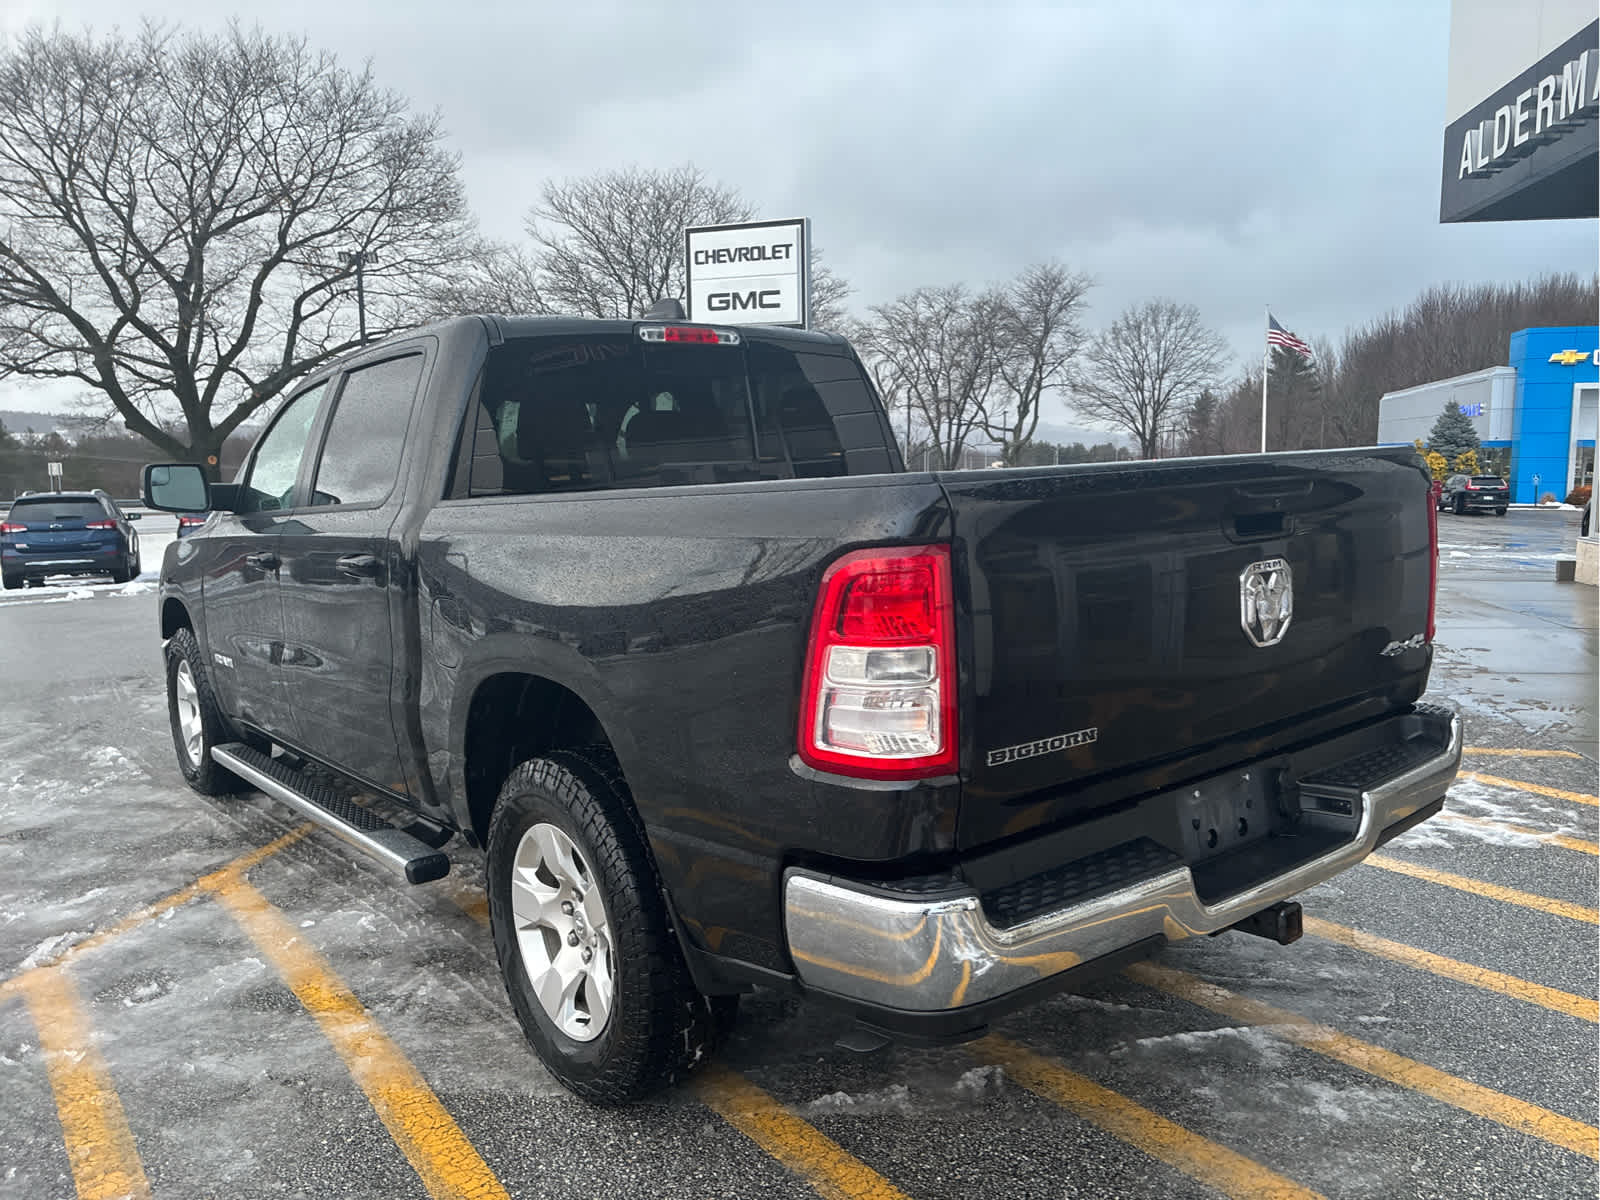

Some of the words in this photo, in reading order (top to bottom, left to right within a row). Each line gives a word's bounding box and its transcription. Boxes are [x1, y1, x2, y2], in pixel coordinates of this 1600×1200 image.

[694, 244, 792, 265] CHEVROLET
[707, 290, 781, 311] GMC
[1252, 560, 1282, 571] RAM
[987, 727, 1098, 766] BIGHORN
